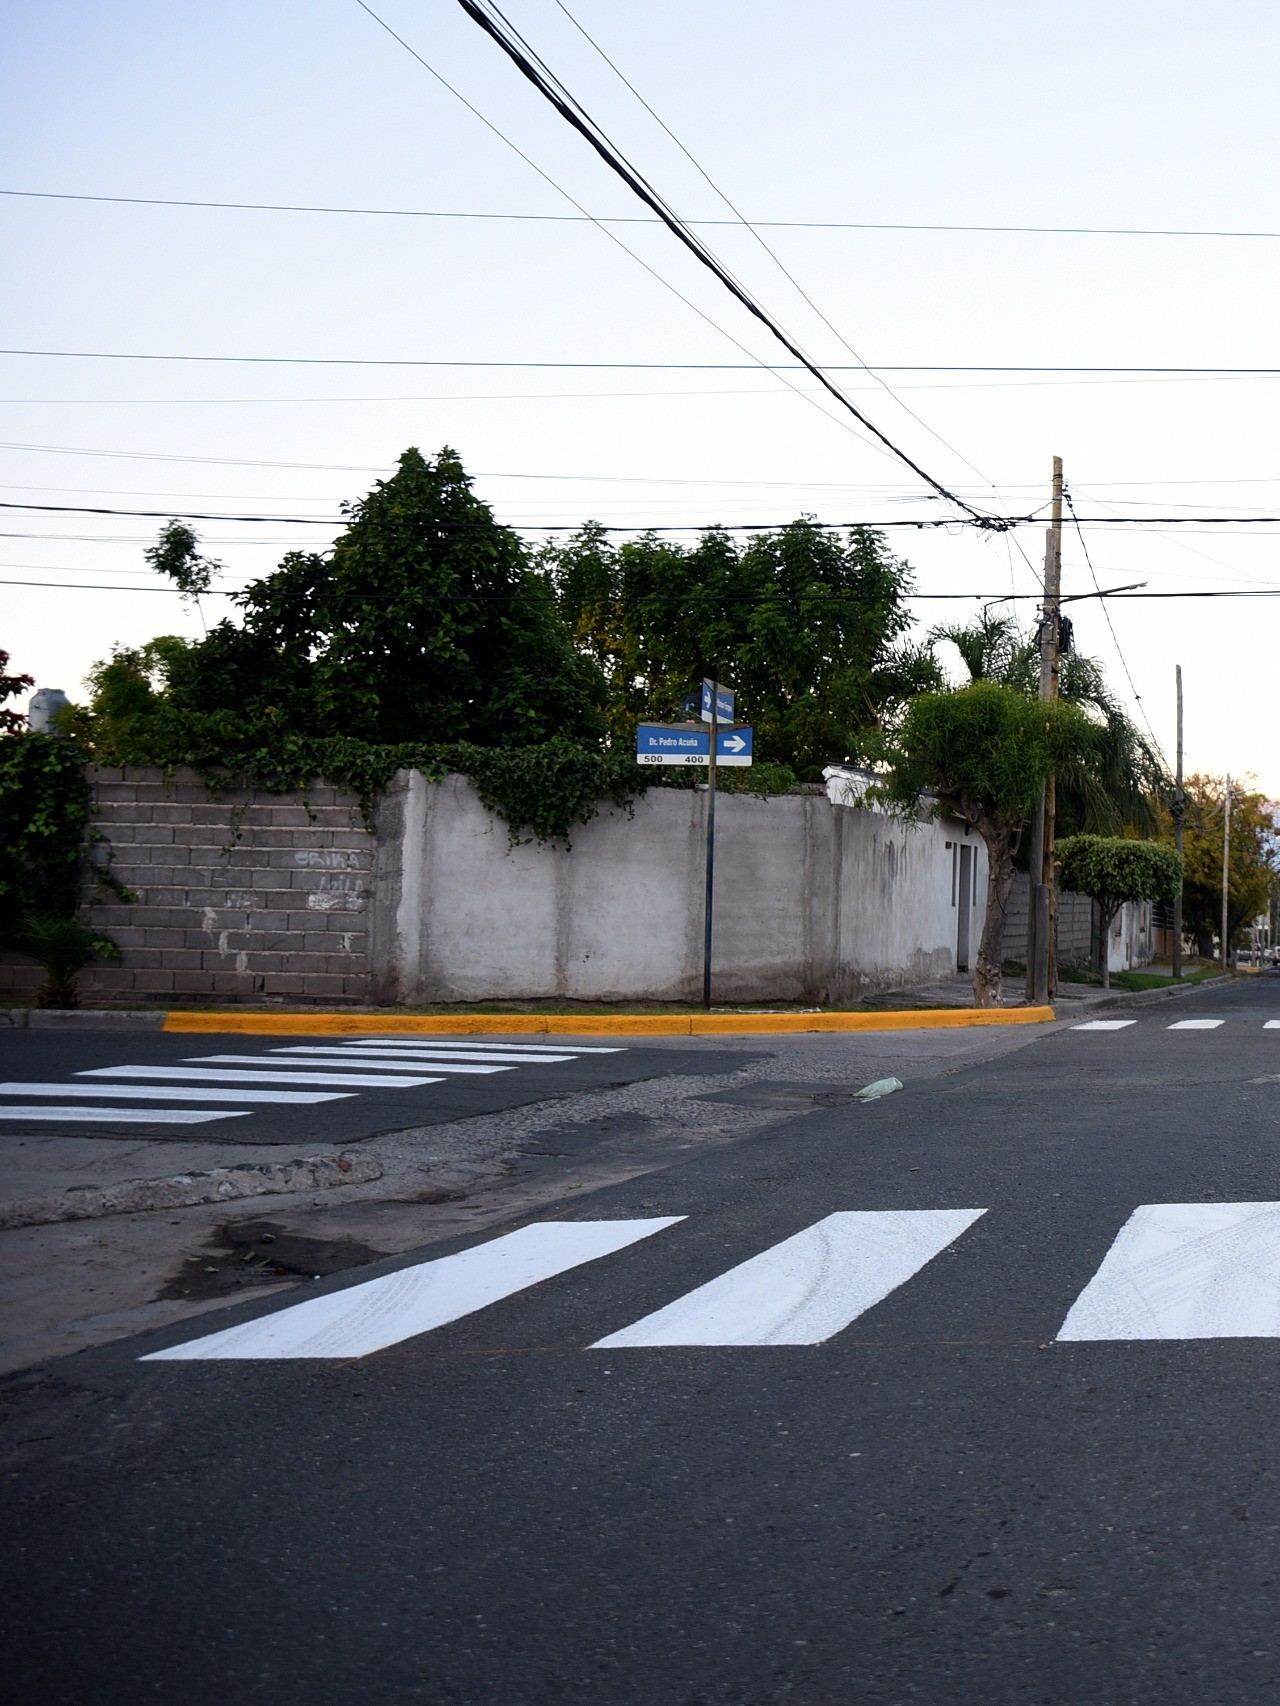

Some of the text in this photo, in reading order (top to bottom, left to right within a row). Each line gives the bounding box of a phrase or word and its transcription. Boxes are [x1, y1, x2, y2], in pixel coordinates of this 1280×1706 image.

[649, 737, 698, 747] Dr. Pedro Acuña
[644, 755, 704, 764] 500 400
